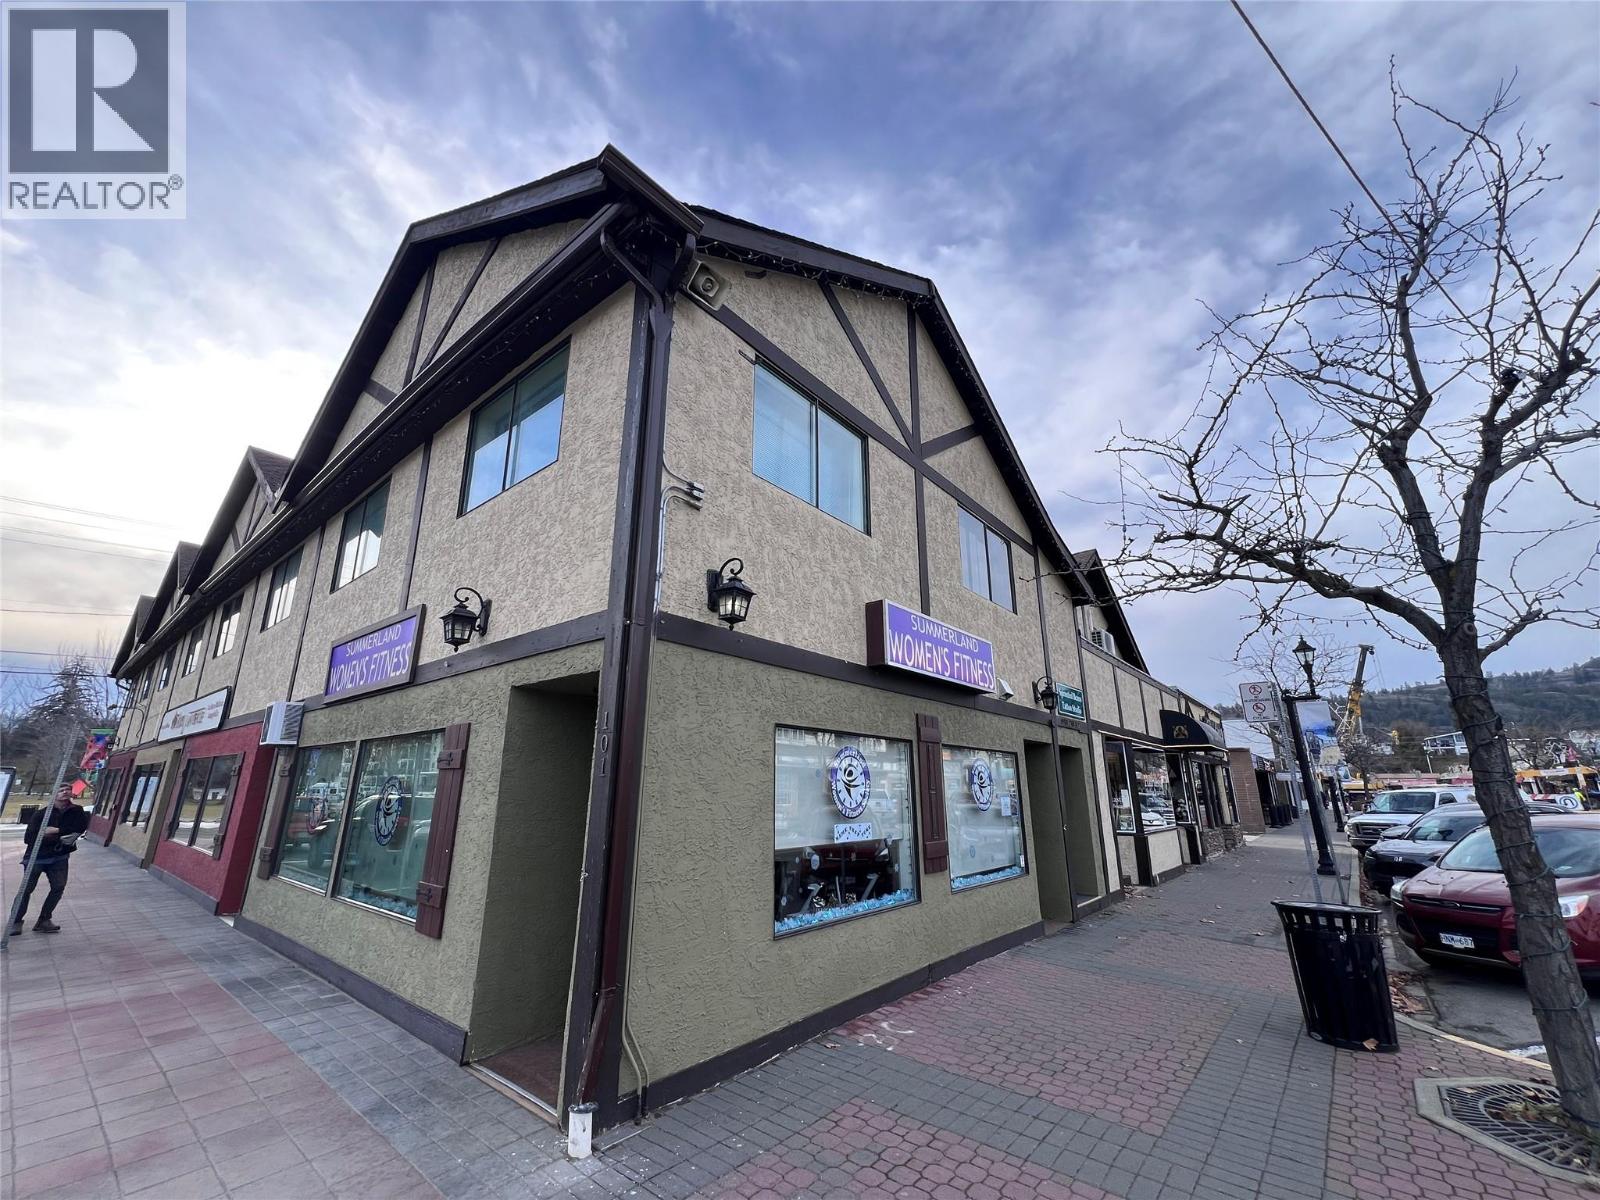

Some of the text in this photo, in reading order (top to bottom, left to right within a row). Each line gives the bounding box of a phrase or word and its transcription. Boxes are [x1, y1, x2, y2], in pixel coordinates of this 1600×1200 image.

[345, 624, 402, 657] SUMMERLAND
[911, 615, 978, 653] SUMMERLAND
[368, 642, 412, 684] FITNESS
[888, 629, 995, 690] WOMEN'S FITNESS
[598, 712, 608, 777] 101
